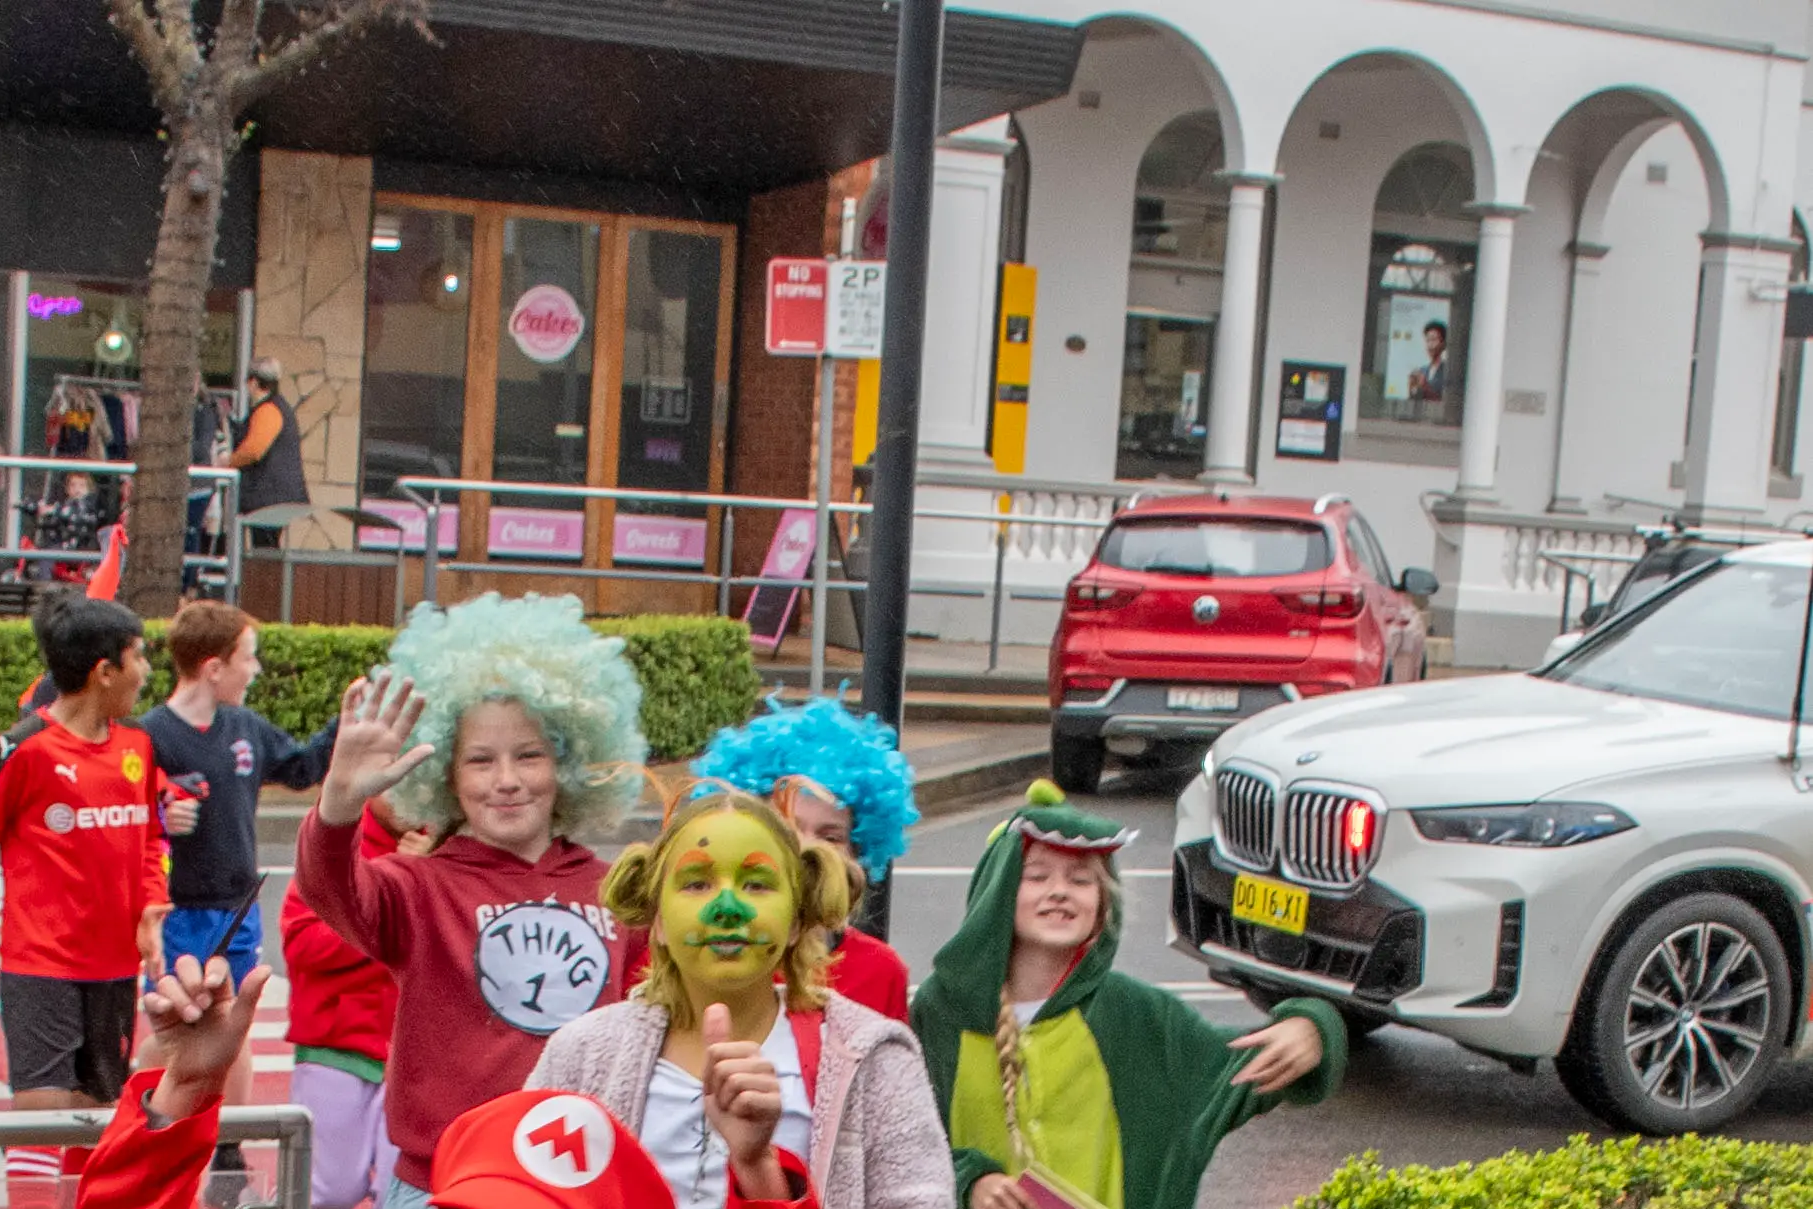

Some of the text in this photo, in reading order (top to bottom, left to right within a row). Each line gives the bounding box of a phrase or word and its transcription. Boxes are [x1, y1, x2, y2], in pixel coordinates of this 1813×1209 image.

[843, 267, 880, 288] 2P
[489, 922, 597, 988] THING
[521, 973, 547, 1013] 1
[526, 1114, 589, 1173] M
